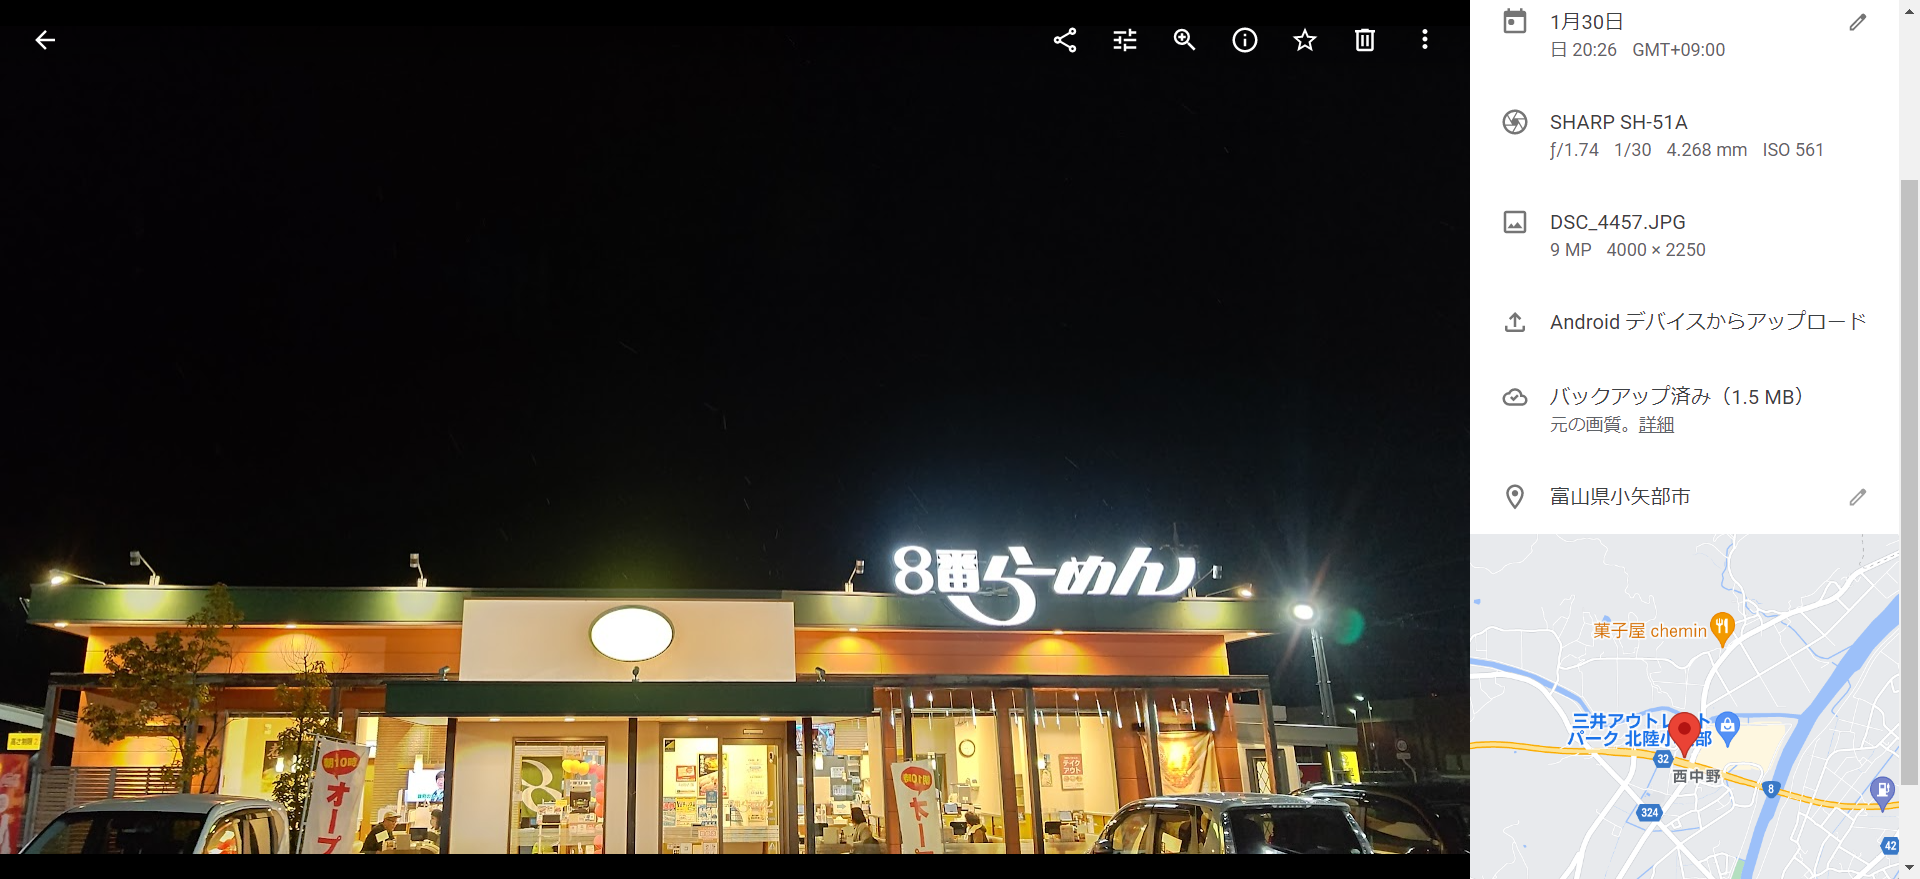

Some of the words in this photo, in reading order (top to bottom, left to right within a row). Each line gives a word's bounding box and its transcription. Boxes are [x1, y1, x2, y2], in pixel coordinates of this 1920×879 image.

[1551, 13, 1622, 30] 1月30日
[1552, 42, 1566, 57] 日
[1573, 43, 1616, 56] 20:26
[1633, 43, 1725, 56] GMT+09:00
[1551, 115, 1614, 129] SHARP
[1621, 115, 1688, 129] SH-51A
[1615, 143, 1651, 157] 1/30
[1667, 143, 1711, 156] 4.268
[1717, 146, 1747, 156] mm
[1764, 143, 1790, 156] ISO
[1796, 143, 1822, 156] 561
[1551, 215, 1685, 231] DSC_4457.JPG
[1551, 243, 1559, 256] 9
[1566, 243, 1591, 256] MP
[1607, 243, 1646, 256] 4000
[1666, 243, 1705, 256] 2250
[1550, 314, 1619, 329] Android
[1626, 310, 1866, 330] デバイスからアップロード
[1551, 487, 1690, 505] 富山県小矢部市
[893, 545, 1196, 626] 8番らーめん
[1594, 622, 1645, 639] 菓子屋
[1651, 623, 1707, 638] chemin
[1572, 712, 1710, 729] 三井アウトレト
[1567, 730, 1618, 747] パーク
[1625, 730, 1712, 747] 北陸小部
[1657, 754, 1669, 763] 32
[1063, 767, 1081, 775] アウト
[1673, 769, 1721, 783] 西中野
[1768, 784, 1774, 793] 8
[1641, 808, 1659, 817] 324
[1885, 841, 1897, 851] 42
